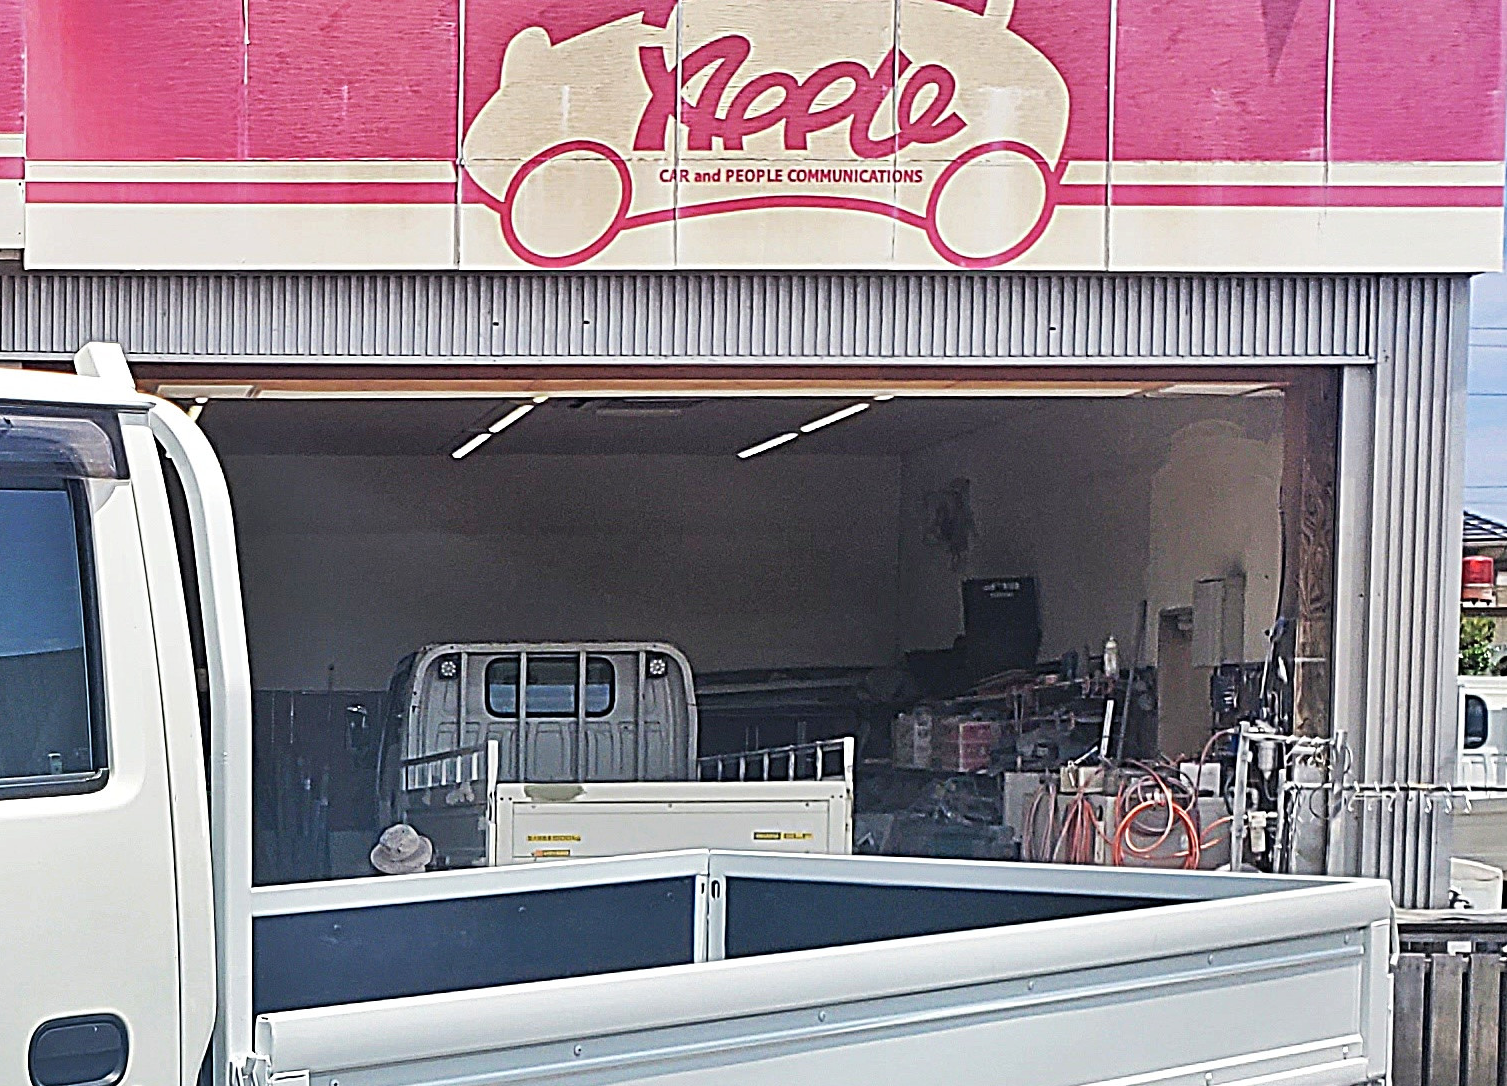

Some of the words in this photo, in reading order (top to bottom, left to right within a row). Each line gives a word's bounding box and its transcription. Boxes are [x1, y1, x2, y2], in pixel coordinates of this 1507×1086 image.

[632, 34, 968, 159] Apple
[659, 168, 688, 183] CAR
[694, 168, 721, 183] and
[725, 168, 783, 183] PEOPLE
[787, 168, 923, 184] COMMUNICATIONS
